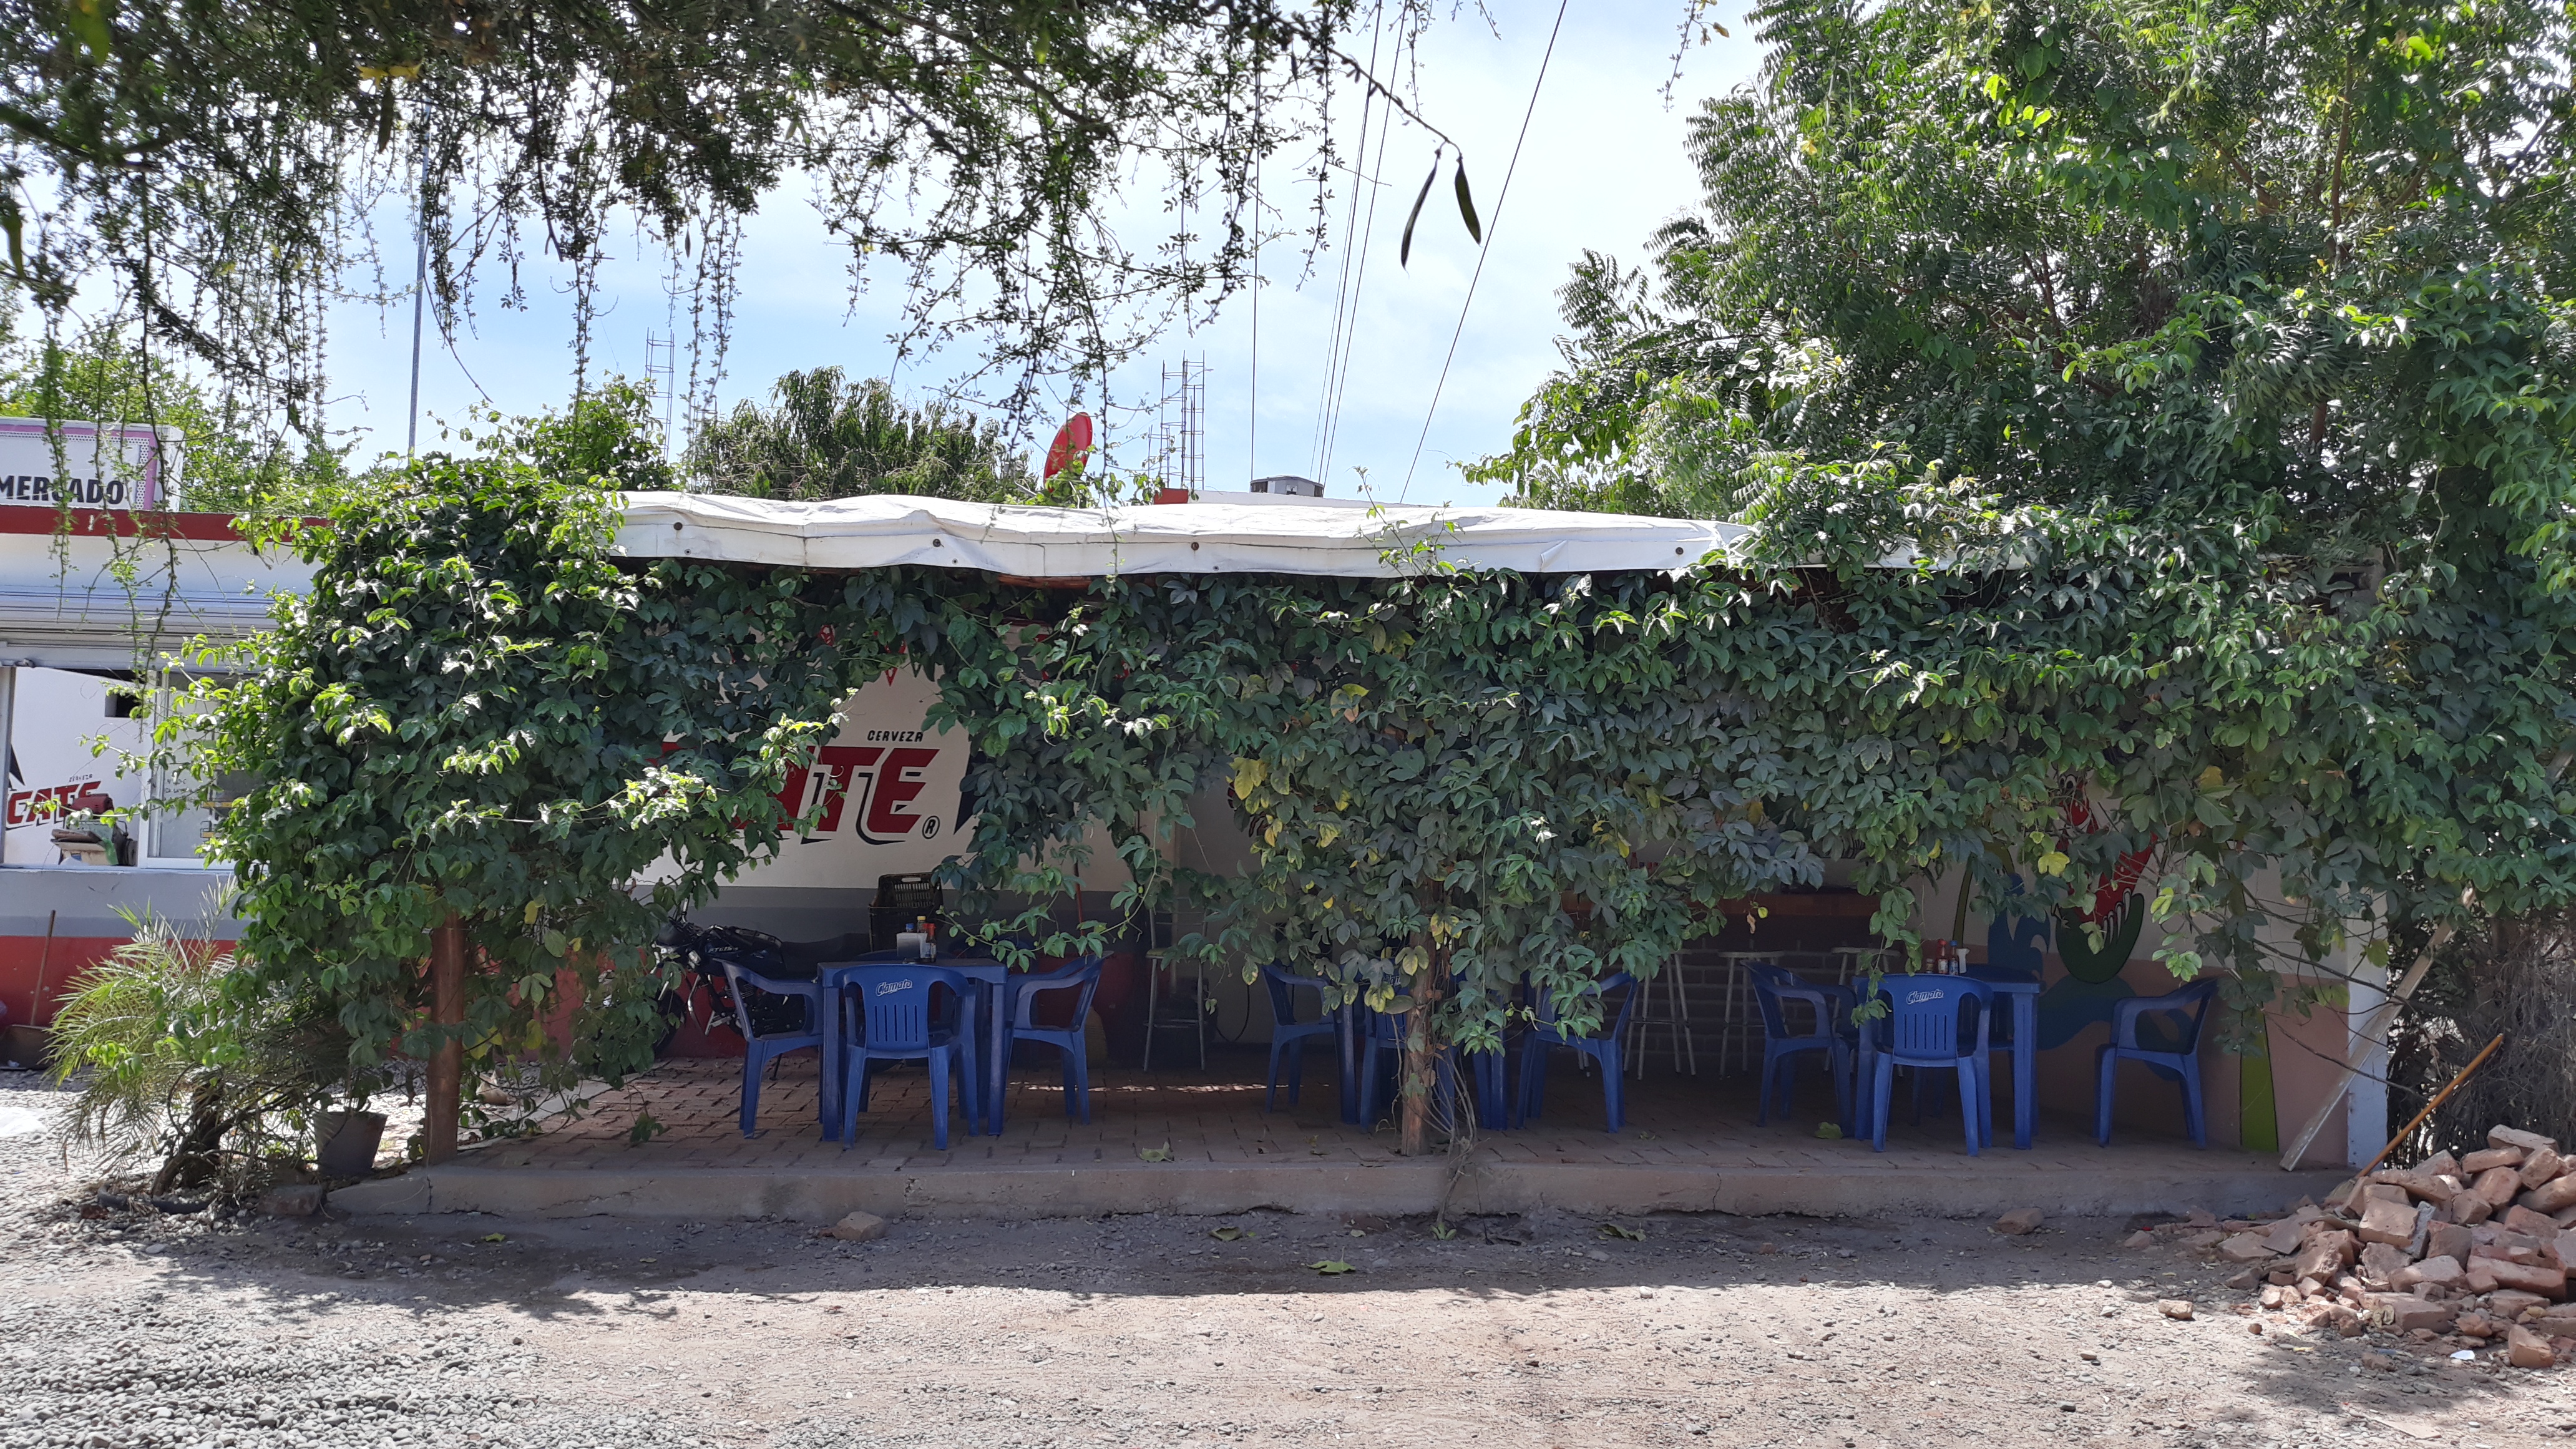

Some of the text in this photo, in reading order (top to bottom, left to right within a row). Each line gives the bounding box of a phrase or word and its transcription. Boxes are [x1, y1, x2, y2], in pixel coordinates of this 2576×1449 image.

[867, 730, 924, 742] CERVEZA
[876, 978, 913, 997] Clamato
[1906, 988, 1944, 1005] Clamato
